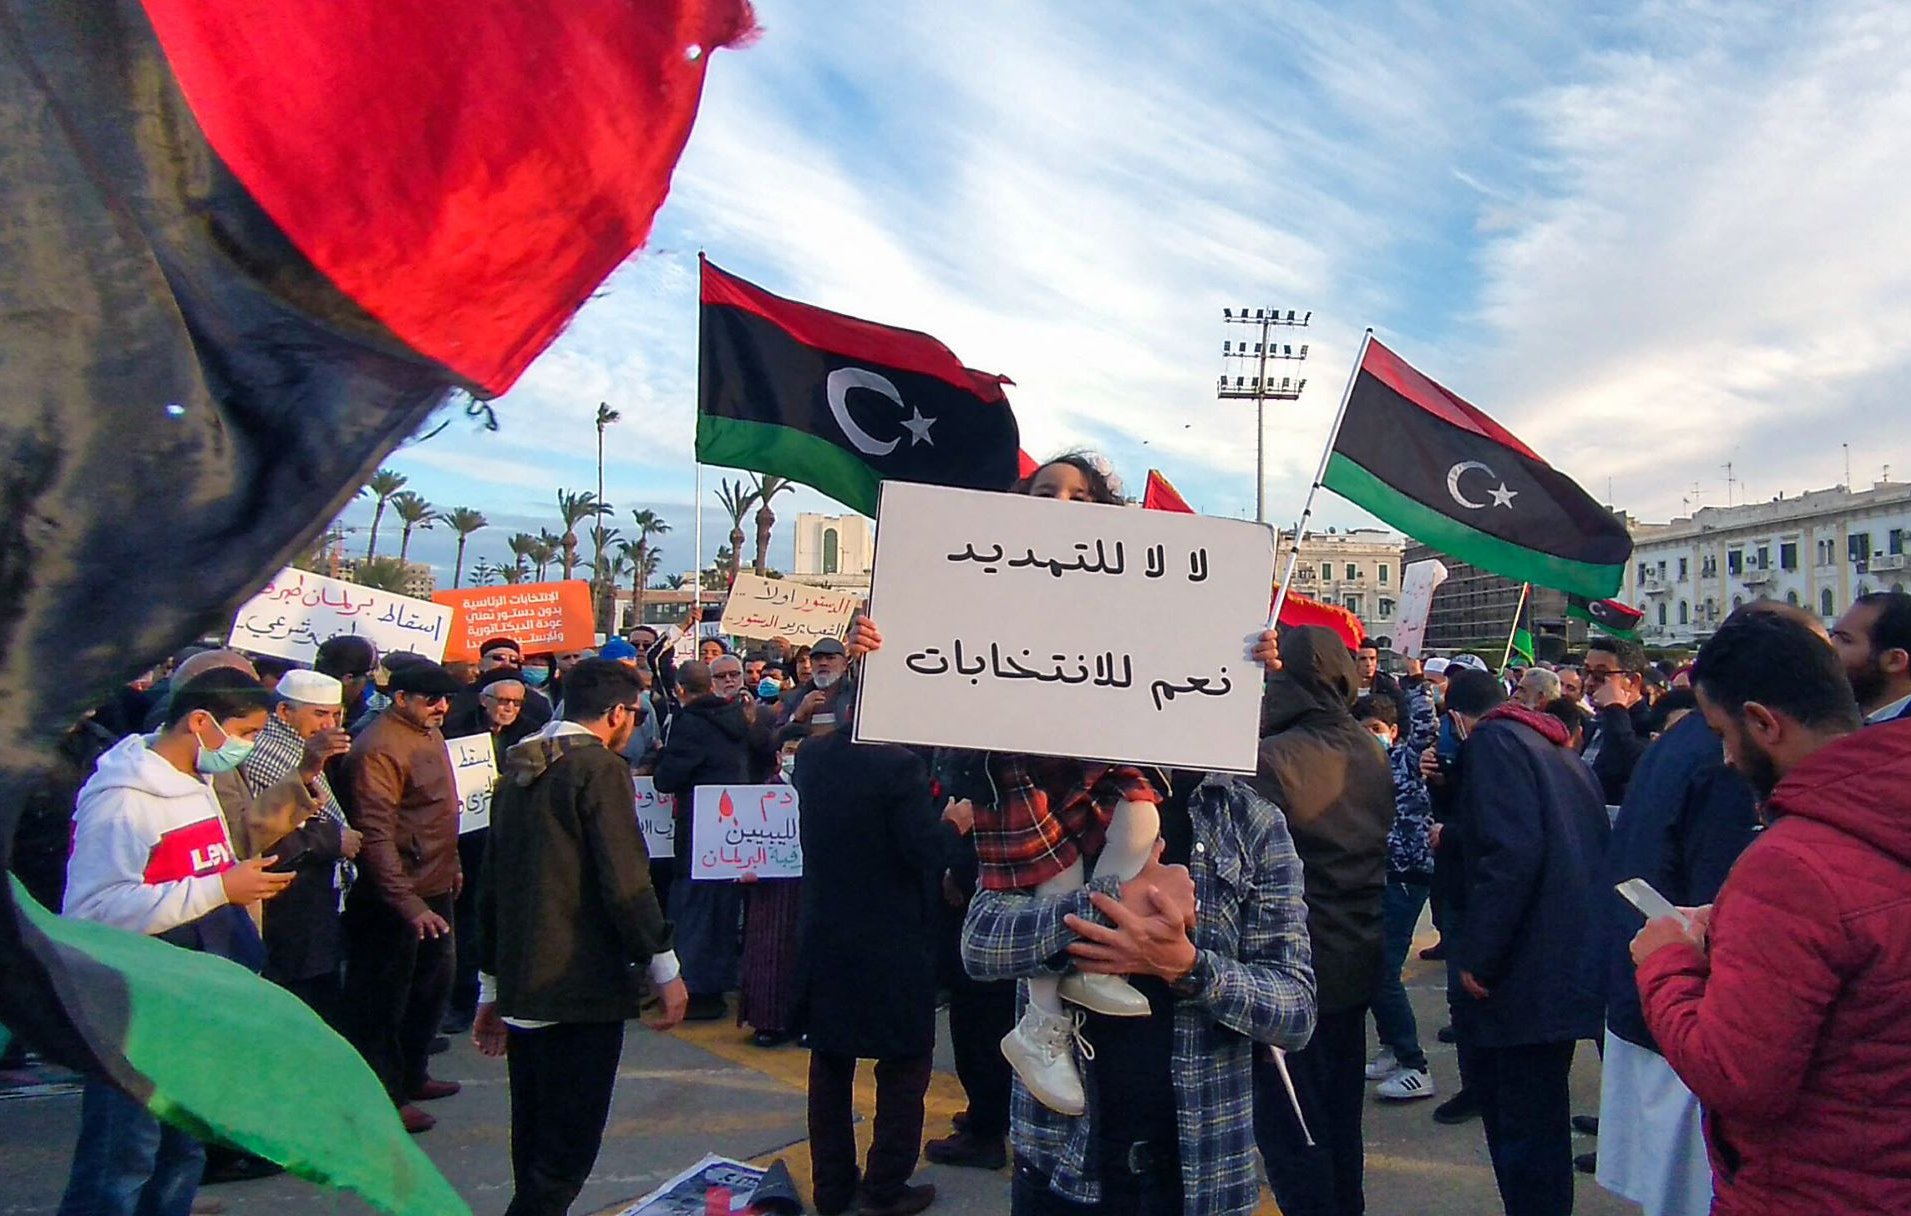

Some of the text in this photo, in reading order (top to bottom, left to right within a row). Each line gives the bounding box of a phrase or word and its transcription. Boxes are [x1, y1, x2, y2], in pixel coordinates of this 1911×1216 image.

[947, 539, 1208, 582] لا لا للتمديد
[302, 587, 373, 615] برلمان
[465, 606, 563, 625] بدون دستور تعني
[377, 602, 442, 641] اسقاط
[905, 639, 1232, 712] نعم للانتخابات
[459, 745, 493, 769] يسقط
[760, 790, 794, 822] دم
[702, 846, 768, 869] البرلمان
